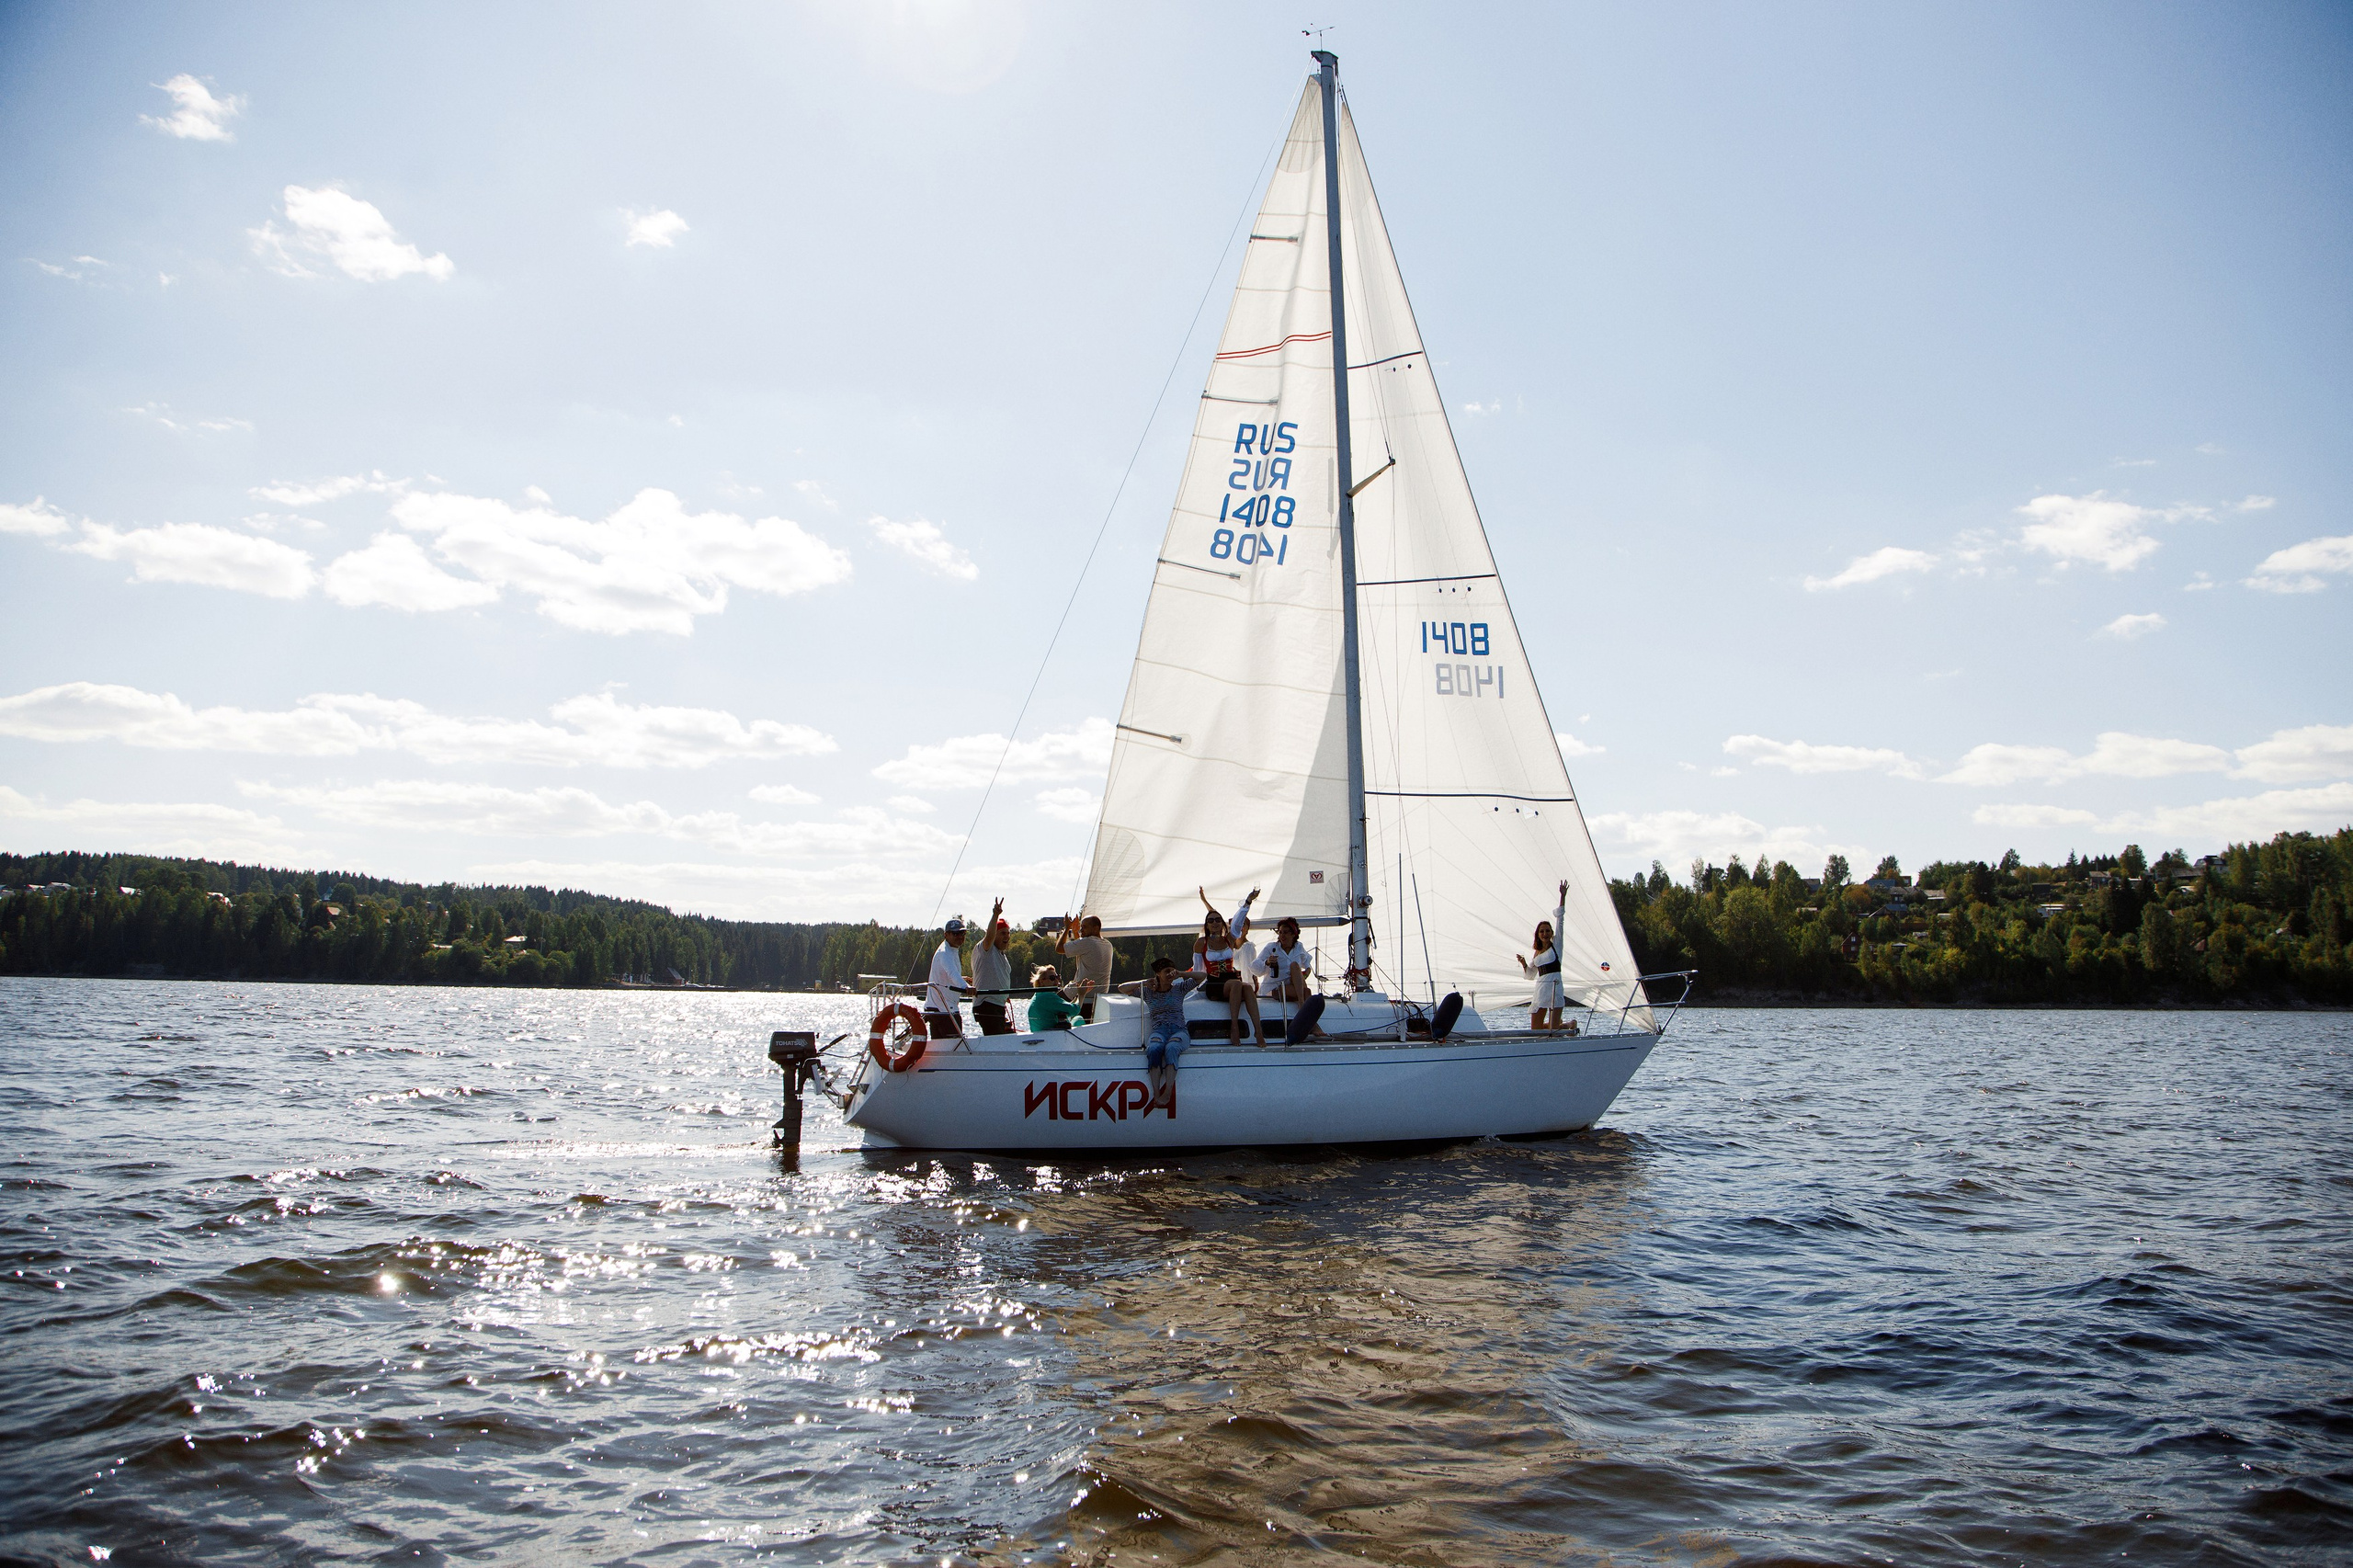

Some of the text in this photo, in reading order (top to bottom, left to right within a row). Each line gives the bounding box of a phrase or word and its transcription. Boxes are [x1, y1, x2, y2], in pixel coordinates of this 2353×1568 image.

[1233, 421, 1299, 455] RUS
[1219, 493, 1296, 528] 1408
[1422, 621, 1490, 655] 1408
[1024, 1079, 1176, 1124] ИСКРА
